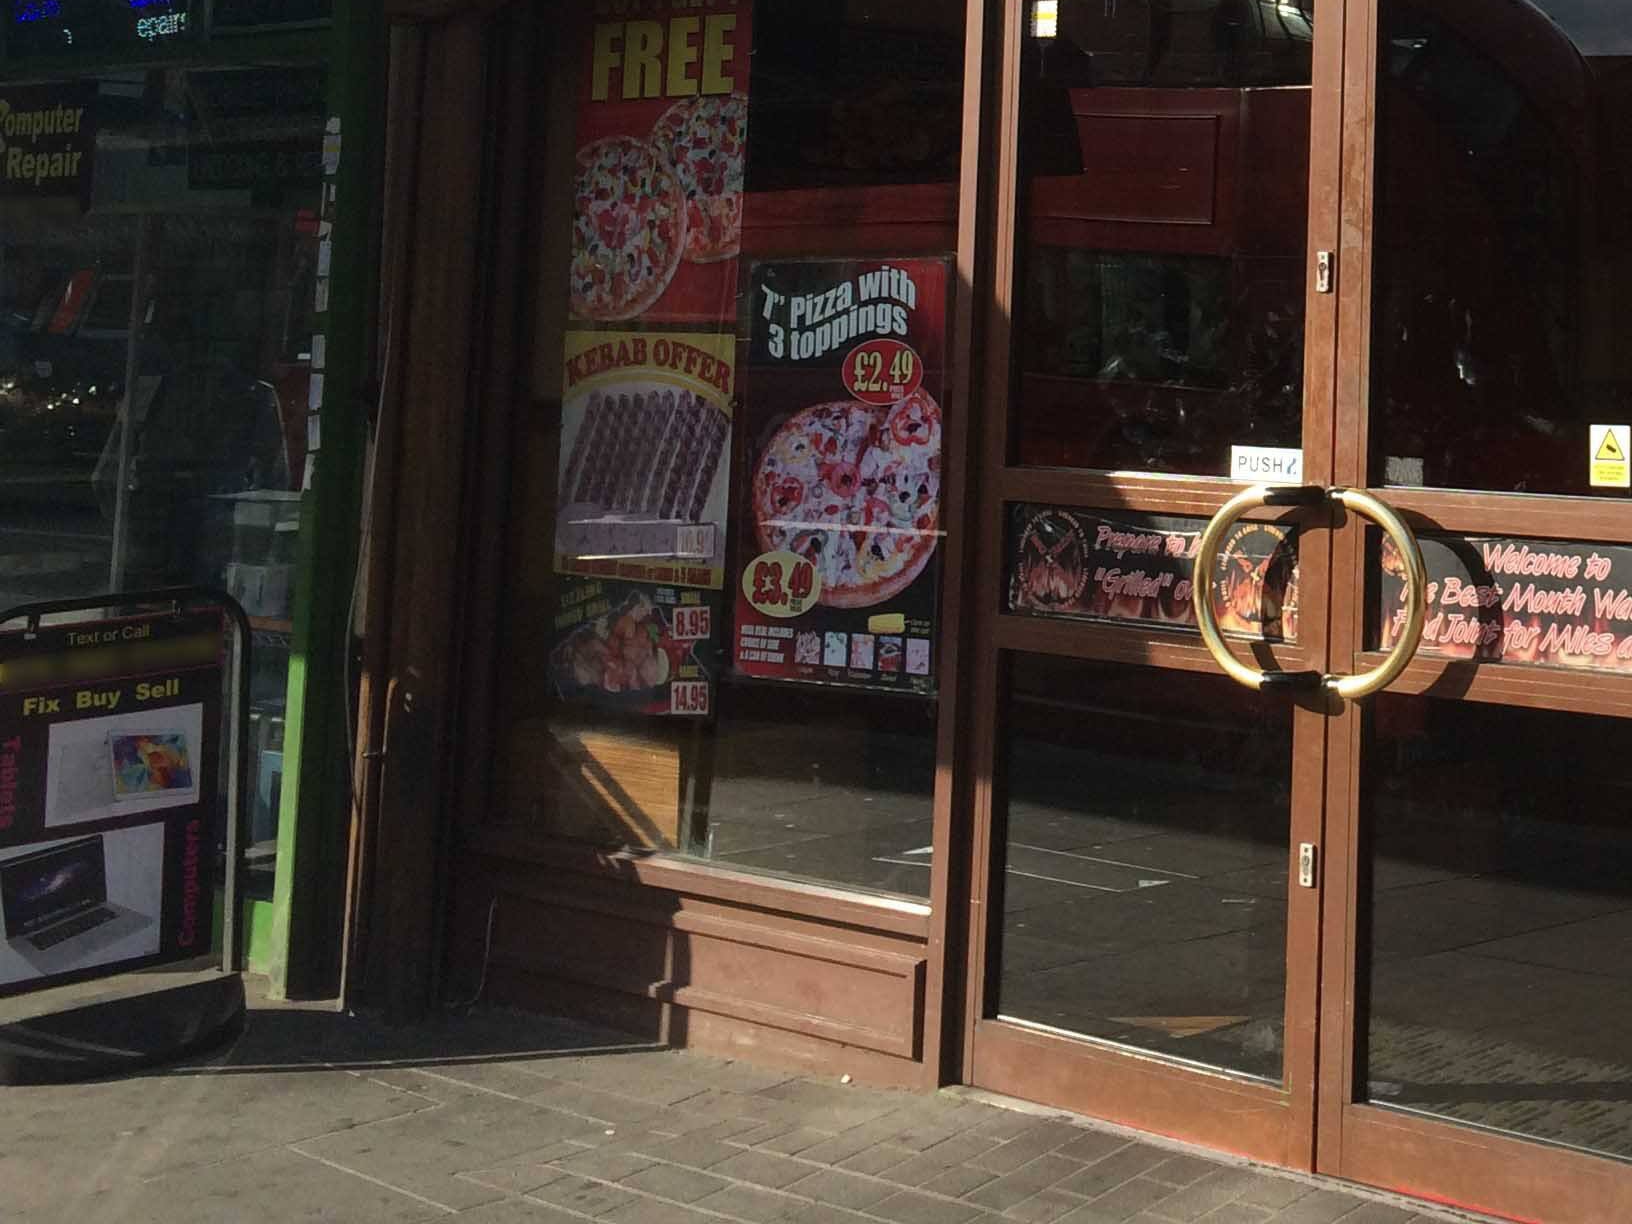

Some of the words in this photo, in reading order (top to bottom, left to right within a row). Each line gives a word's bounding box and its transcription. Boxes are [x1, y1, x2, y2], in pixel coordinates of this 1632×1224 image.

[592, 14, 737, 101] FREE
[6, 143, 82, 186] Repair
[790, 279, 853, 324] Pizza
[859, 264, 917, 311] with
[768, 322, 785, 359] 3
[790, 302, 909, 361] toppings
[566, 337, 647, 387] KEBAB
[653, 337, 733, 395] OFFER
[852, 349, 913, 392] £2.49
[1237, 455, 1284, 474] PUSH
[1483, 542, 1579, 578] Welcome
[1584, 552, 1612, 581] to
[1440, 577, 1503, 608] Best
[1504, 582, 1586, 616] Mouth
[67, 628, 100, 646] Text
[102, 628, 118, 642] or
[122, 623, 151, 641] Call
[674, 608, 710, 637] 8.95
[1502, 620, 1540, 655] for
[1540, 624, 1614, 655] Miles
[23, 696, 60, 717] Fix
[76, 687, 121, 710] Buy
[136, 678, 180, 701] Sell
